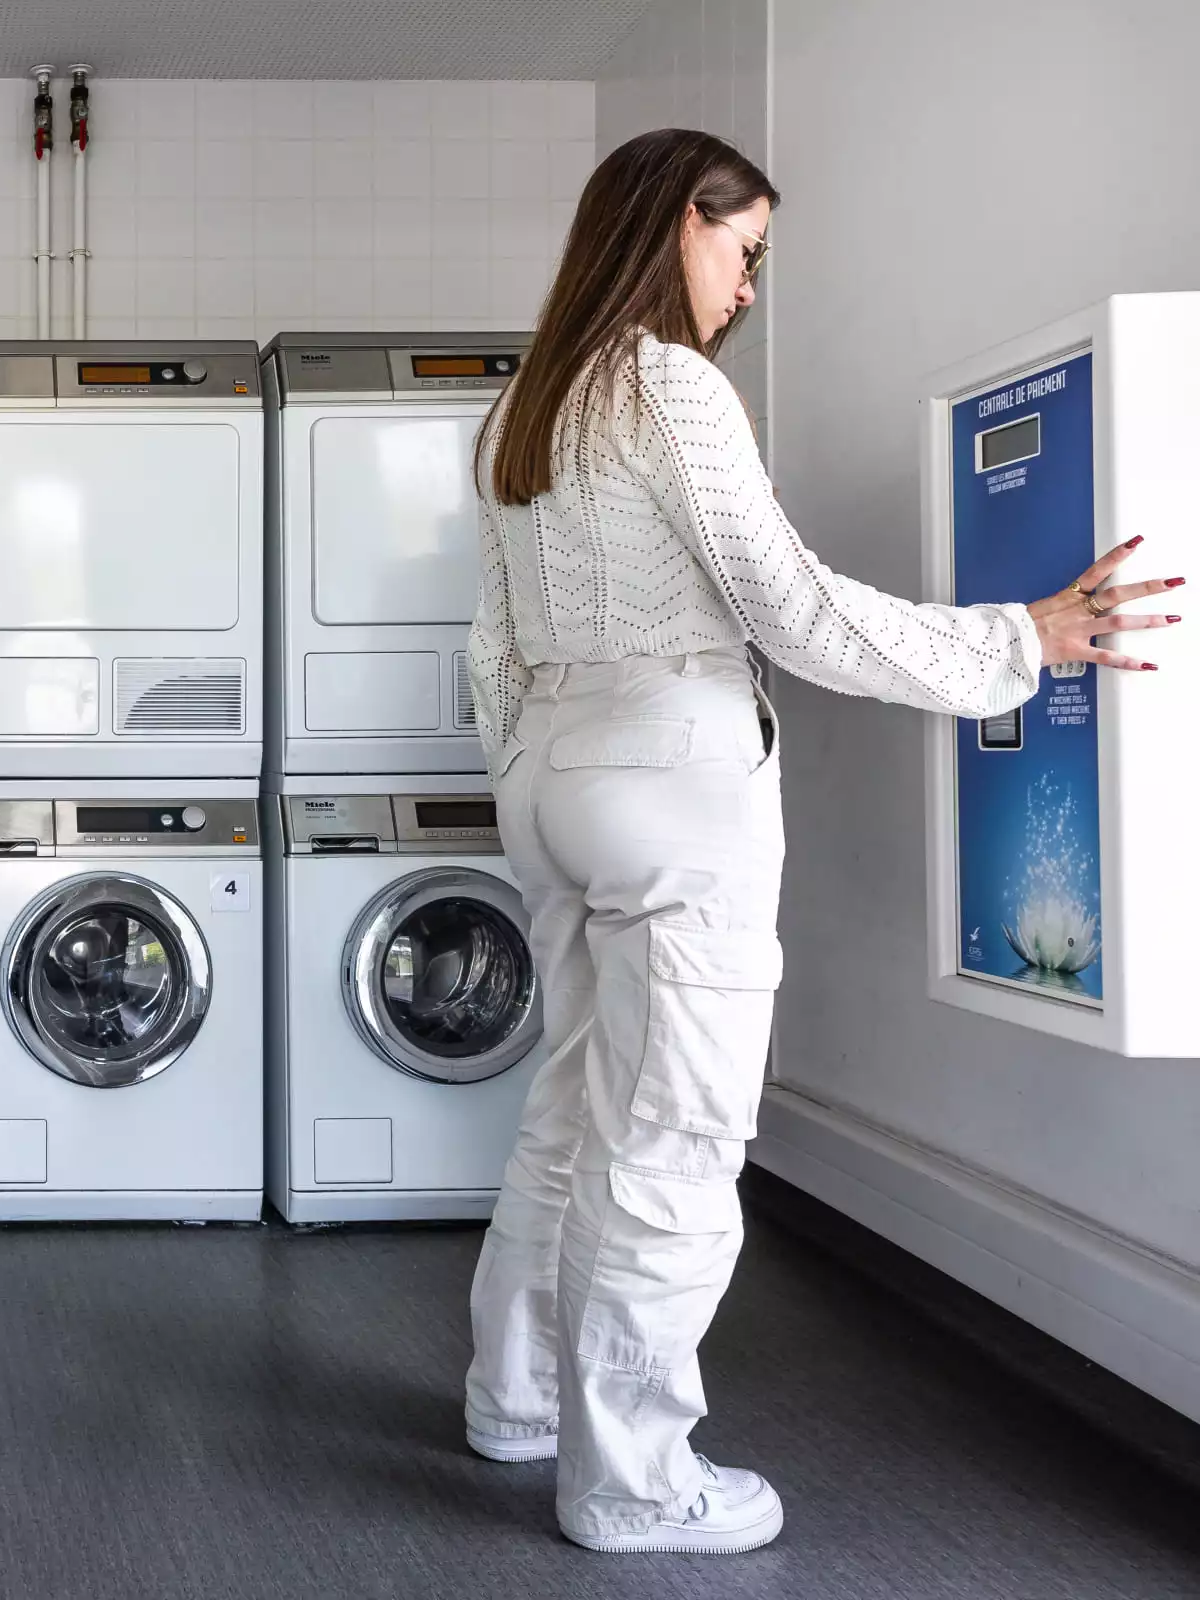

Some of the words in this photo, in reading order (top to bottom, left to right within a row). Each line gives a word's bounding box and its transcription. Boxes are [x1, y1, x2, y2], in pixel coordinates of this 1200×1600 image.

[978, 389, 1014, 418] CENTRALE
[1015, 385, 1025, 405] DE
[1027, 369, 1067, 401] PAIEMENT
[225, 880, 237, 895] 4
